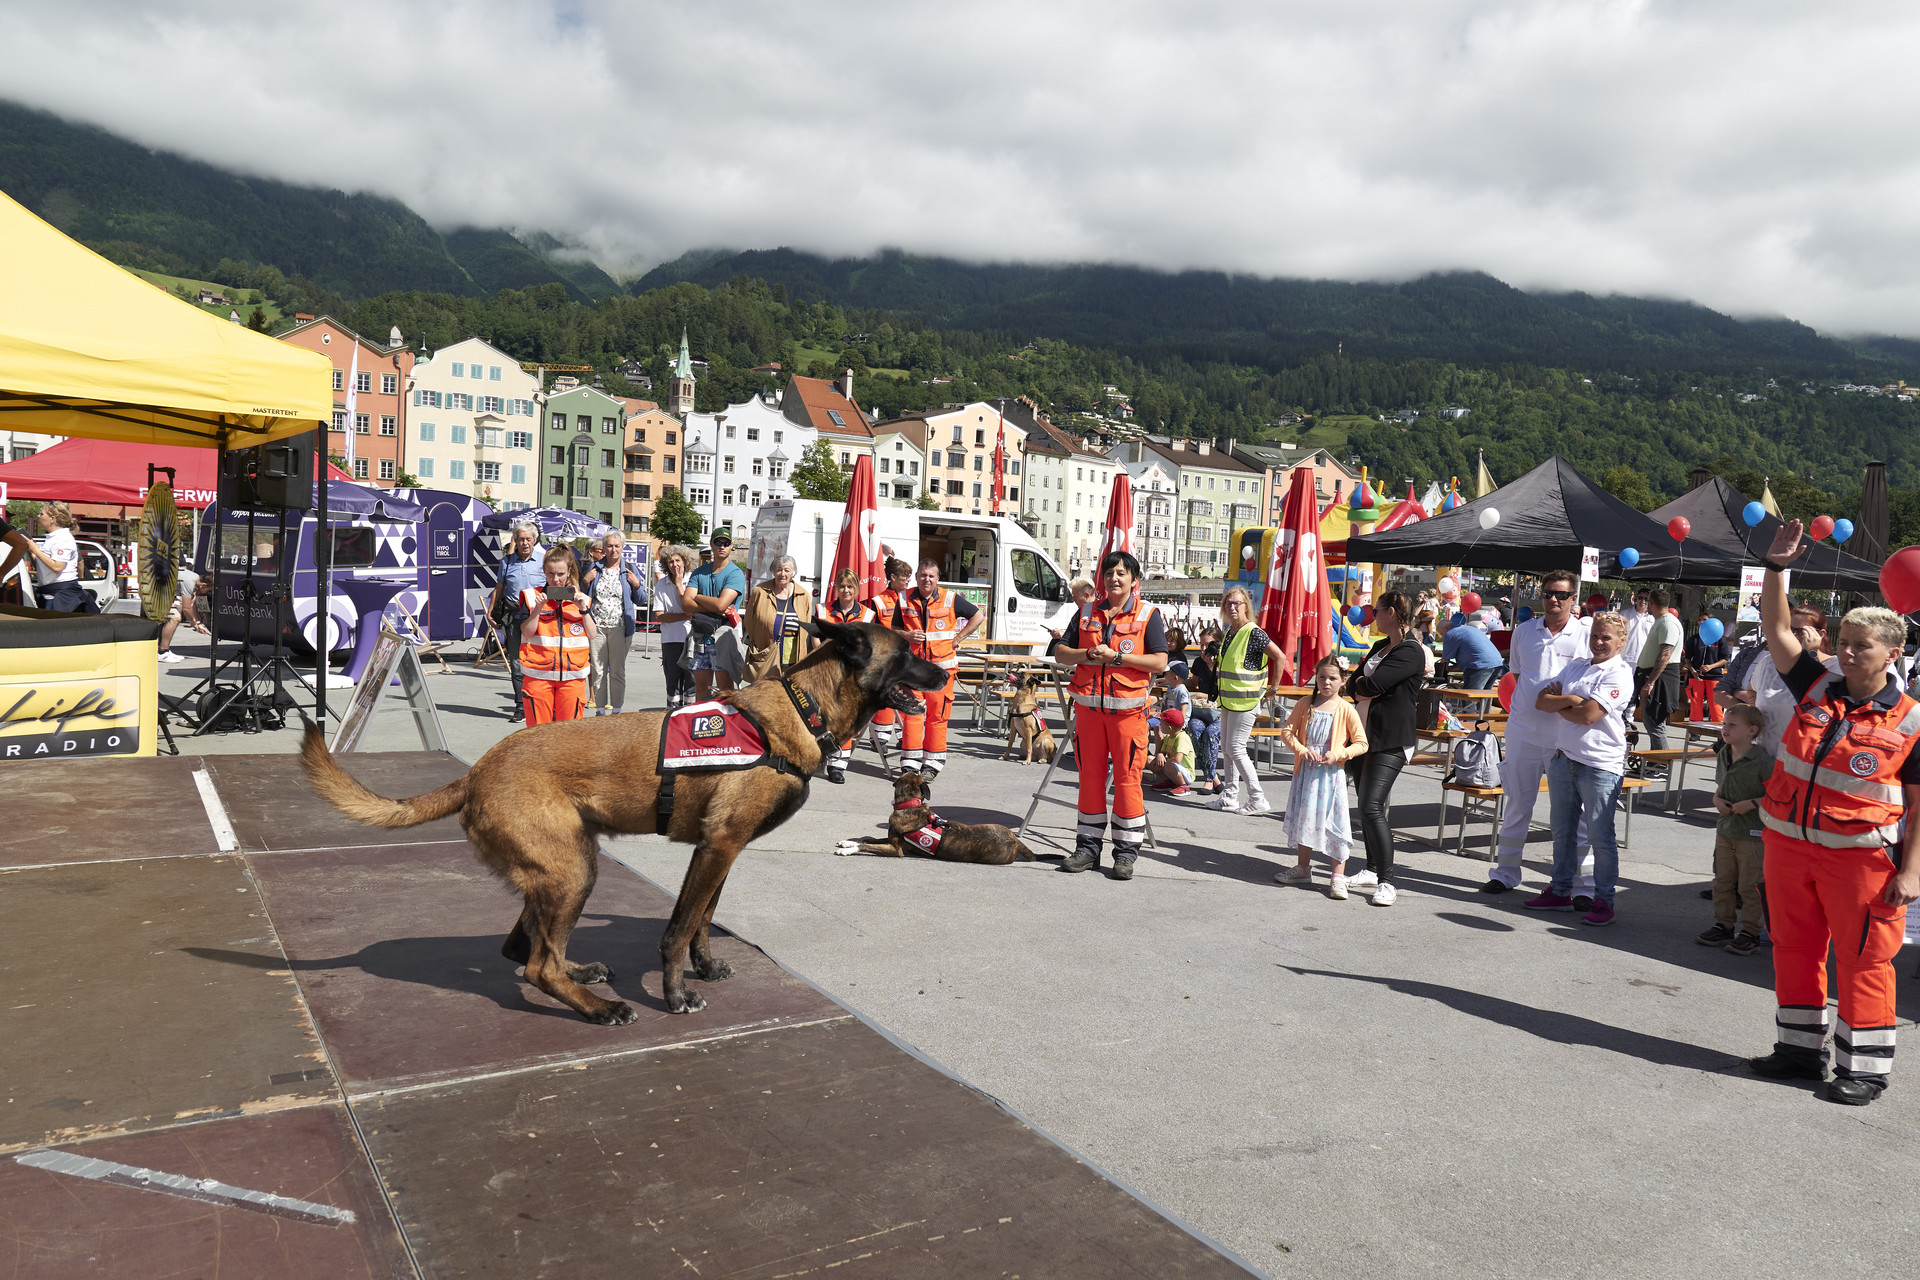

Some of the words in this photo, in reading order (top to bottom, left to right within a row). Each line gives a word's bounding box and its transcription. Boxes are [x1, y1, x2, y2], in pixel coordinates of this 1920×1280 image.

[252, 407, 298, 416] MASTERTENT
[139, 487, 217, 502] FERW
[218, 602, 274, 619] Landebank
[6, 735, 121, 757] RADIO
[680, 746, 741, 757] RETTUNGSHUND
